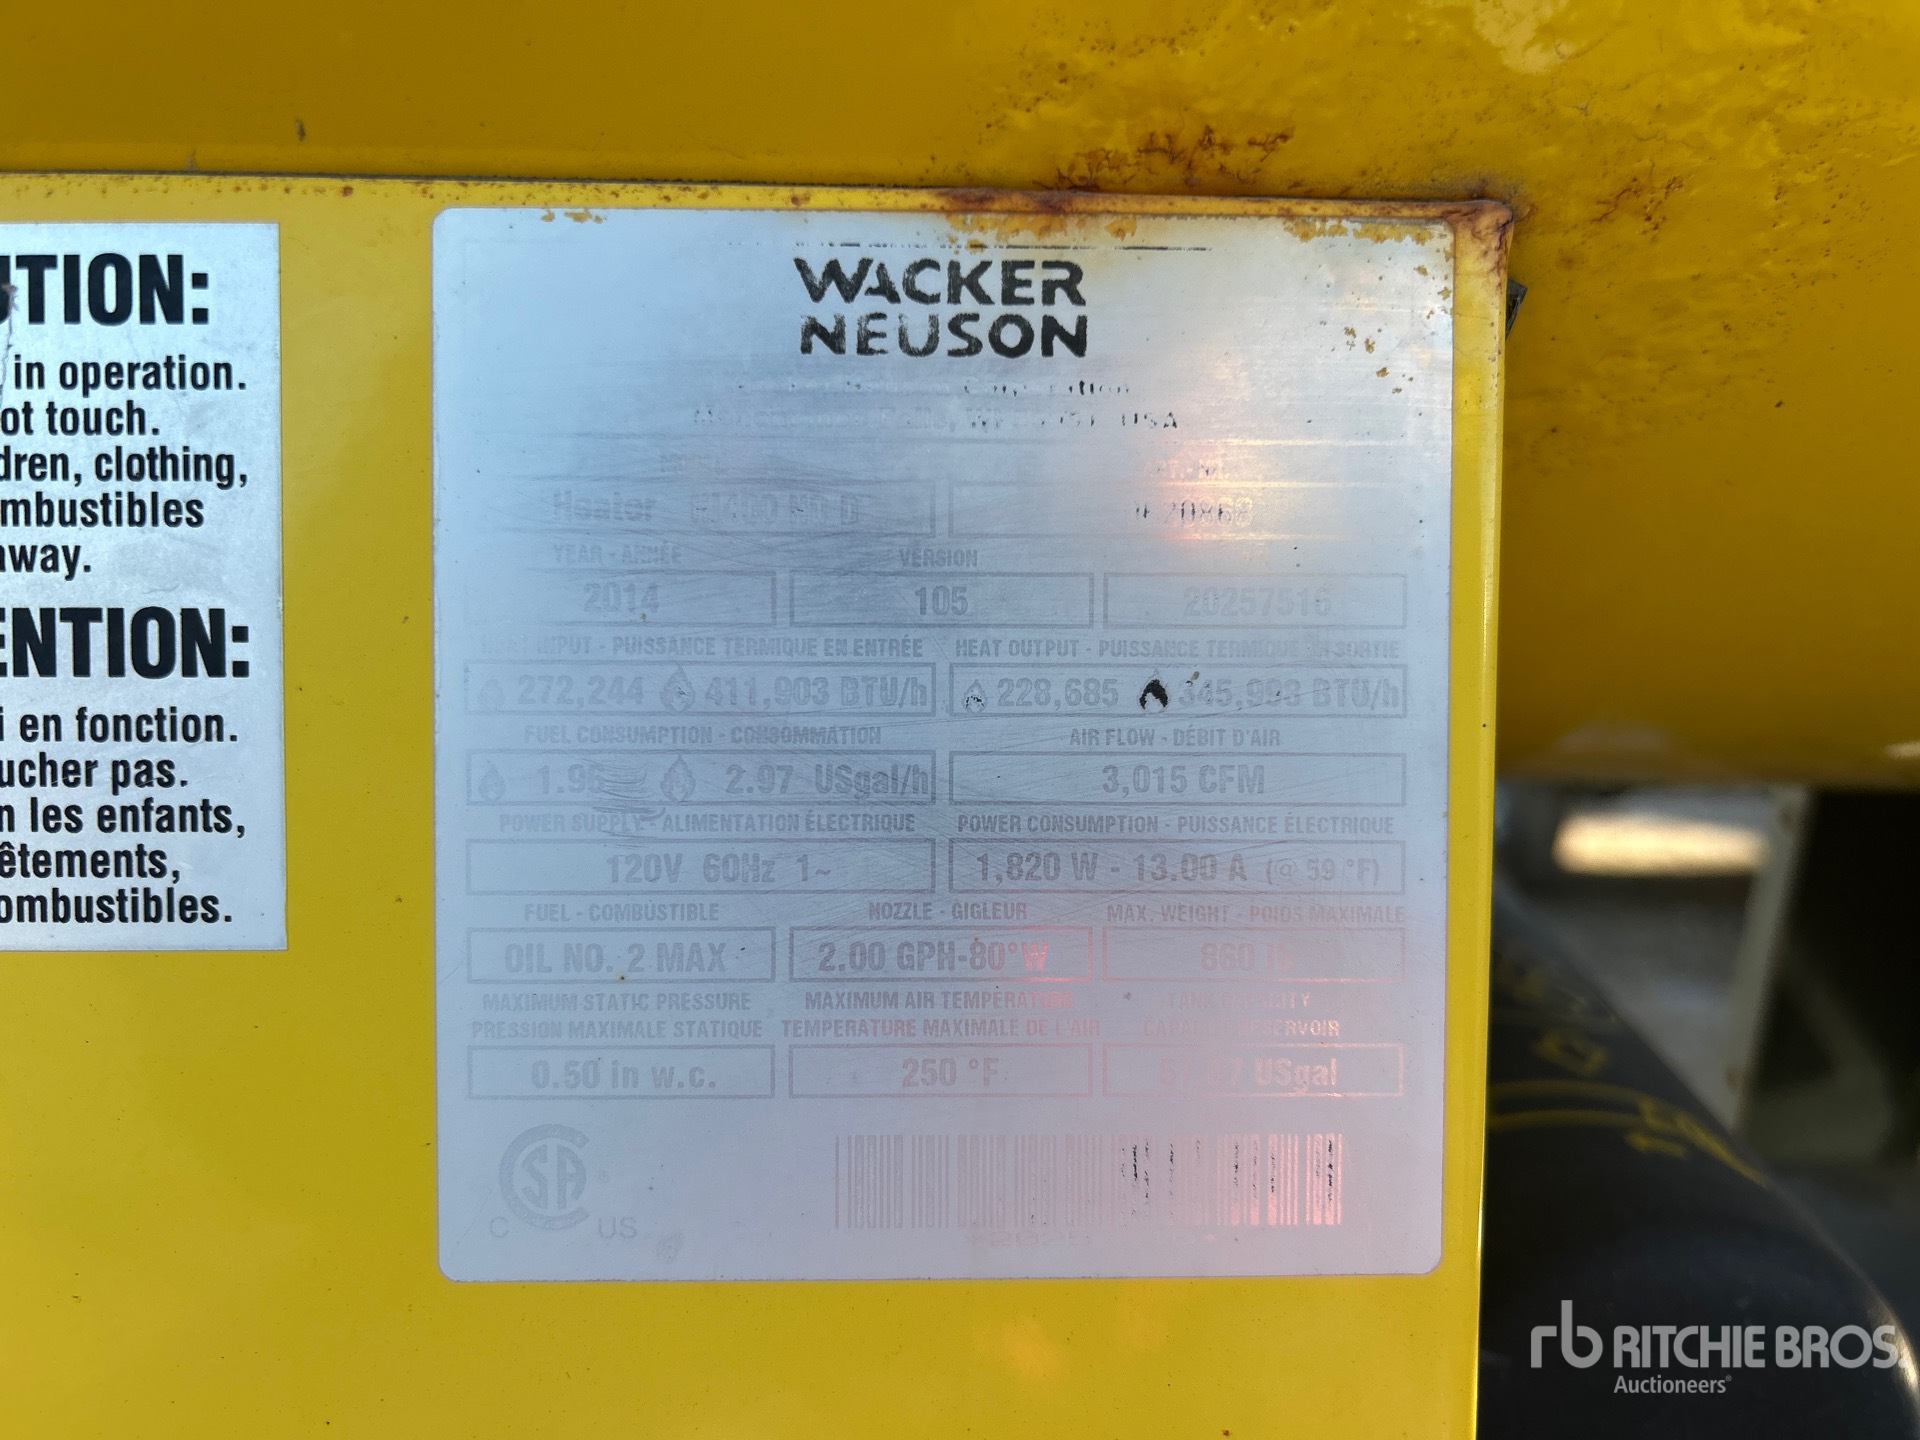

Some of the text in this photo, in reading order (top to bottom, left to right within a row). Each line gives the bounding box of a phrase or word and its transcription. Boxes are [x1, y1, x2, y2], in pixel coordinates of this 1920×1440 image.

[0, 252, 210, 326] TION:
[793, 256, 1087, 307] WACKER
[799, 312, 1087, 358] NEUSON
[13, 354, 248, 398] in operation.
[46, 401, 161, 437] touch.
[93, 446, 248, 490] clothing,
[1, 491, 205, 528] mbustibles
[554, 544, 601, 565] YEAR
[900, 549, 978, 568] VERSION
[583, 582, 661, 614] 2014
[914, 586, 969, 616] 105
[1183, 586, 1332, 617] 20257516
[0, 607, 250, 679] NTION:
[612, 636, 716, 656] PUISSANCE
[722, 637, 818, 657] TERMIQUE
[823, 638, 849, 657] EN
[853, 633, 924, 658] ENTRÉE
[955, 639, 1001, 658] HEAT
[1008, 639, 1079, 658] OUTPUT
[1098, 639, 1200, 658] PUISSANCE
[1206, 639, 1299, 658] TERMIQUE
[1335, 639, 1400, 658] SORTIE
[517, 674, 927, 709] 272,244 411,903 BTU/h
[996, 677, 1119, 711] 228,685
[1312, 677, 1399, 711] BTU/h
[19, 713, 62, 743] en
[77, 705, 238, 743] fonction.
[523, 726, 572, 745] FUEL
[576, 726, 713, 745] CONSUMPTION
[730, 726, 882, 745] CONSOMMATION
[1069, 728, 1102, 746] AIR
[1105, 728, 1156, 746] FLOW
[1172, 723, 1226, 746] DÉBIT
[1232, 728, 1281, 746] D'AIR
[111, 758, 189, 796] pas.
[725, 764, 794, 795] 2.97
[814, 763, 929, 800] USgal/h
[1101, 765, 1266, 799] 3,015 CFM
[31, 797, 84, 833] les
[97, 797, 246, 838] enfants,
[499, 813, 567, 832] POWER
[662, 813, 799, 833] ALIMENTATION
[804, 809, 916, 834] ÉLECTRIQUE
[957, 815, 1021, 835] POWER
[1026, 815, 1158, 835] CONSUMPTION
[1177, 815, 1279, 835] PUISSANCE
[1284, 811, 1395, 836] ÉLECTRIQUE
[606, 853, 683, 884] 120V
[702, 853, 776, 884] 60Hz
[975, 852, 1062, 886] 1,820
[1071, 852, 1099, 882] W
[1135, 852, 1217, 882] 13.00
[1228, 852, 1248, 882] A
[1306, 859, 1336, 882] 59
[524, 902, 571, 921] FUEL
[589, 902, 720, 921] COMBUSTIBLE
[868, 902, 933, 921] NOZZLE
[951, 902, 1028, 921] GIGLEUR
[1106, 904, 1154, 924] MAX.
[1160, 904, 1230, 924] WEIGHT
[1249, 904, 1301, 924] POIDS
[1309, 904, 1406, 924] MAXIMALE
[504, 943, 728, 973] OIL NO. 2 MAX
[817, 939, 1048, 972] 2.00 GPH-80°W
[1200, 943, 1256, 973] 860
[482, 991, 752, 1010] MAXIMUM STATIC PRESSURE
[805, 991, 899, 1010] MAXIMUM
[904, 991, 936, 1010] AIR
[472, 1020, 764, 1039] PRESSION MAXIMALE STATIQUE
[781, 1019, 1101, 1038] TEMPERATURE MAXIMALE DE L'AIR
[1143, 1019, 1233, 1038] CAPACIT
[530, 1060, 717, 1090] 0.50 in w.c.
[901, 1058, 1001, 1088] 250 °F
[1253, 1057, 1338, 1093] USgal
[598, 1215, 638, 1239] US
